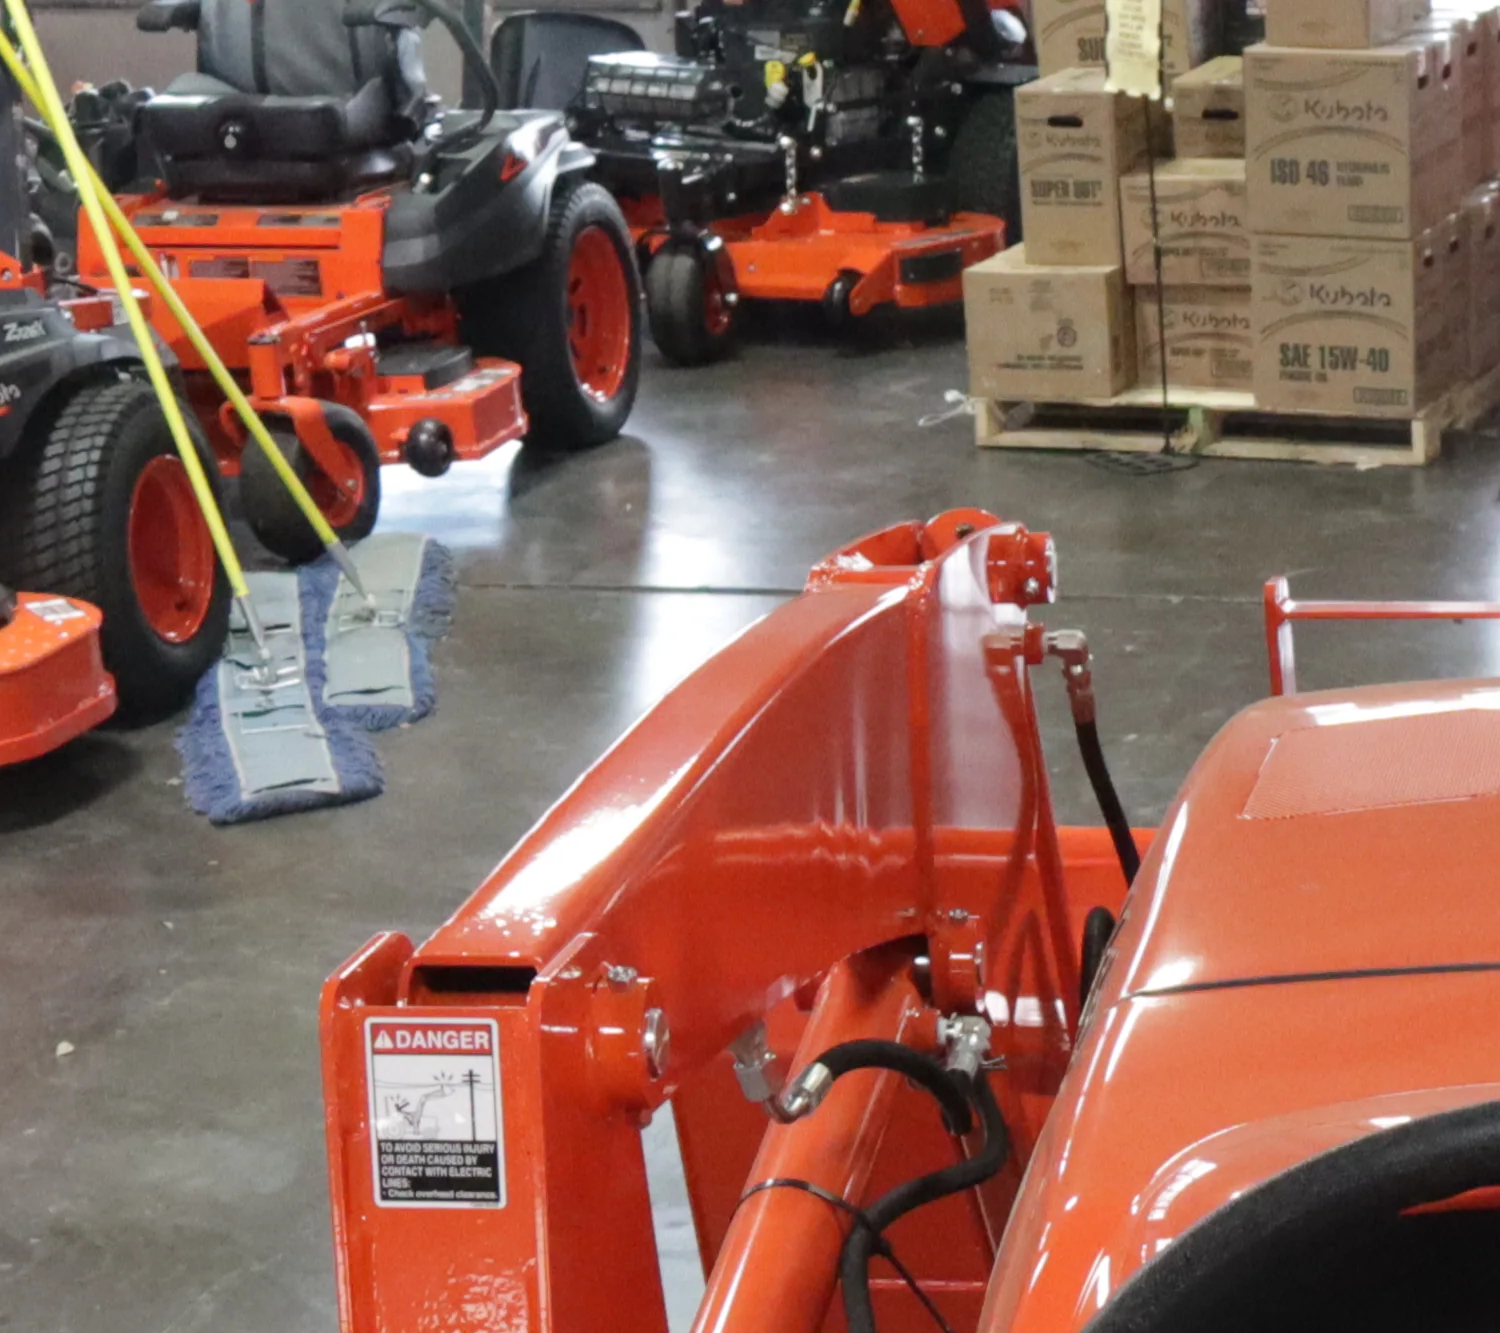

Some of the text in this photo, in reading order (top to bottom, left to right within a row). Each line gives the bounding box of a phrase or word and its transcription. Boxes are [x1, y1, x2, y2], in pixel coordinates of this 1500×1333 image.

[1304, 100, 1388, 122] Kubota
[1270, 158, 1329, 186] ISO 46
[1170, 211, 1242, 228] Kubota
[1309, 285, 1392, 307] Kubota
[1279, 343, 1389, 372] SAE 15W-40
[395, 1030, 490, 1050] DANGER
[380, 1143, 494, 1154] TO AVOID SERIOUS INJURY
[381, 1155, 478, 1165] OR DEATH CAUSED BY
[381, 1167, 492, 1177] CONTACT WITH ELECTRIC
